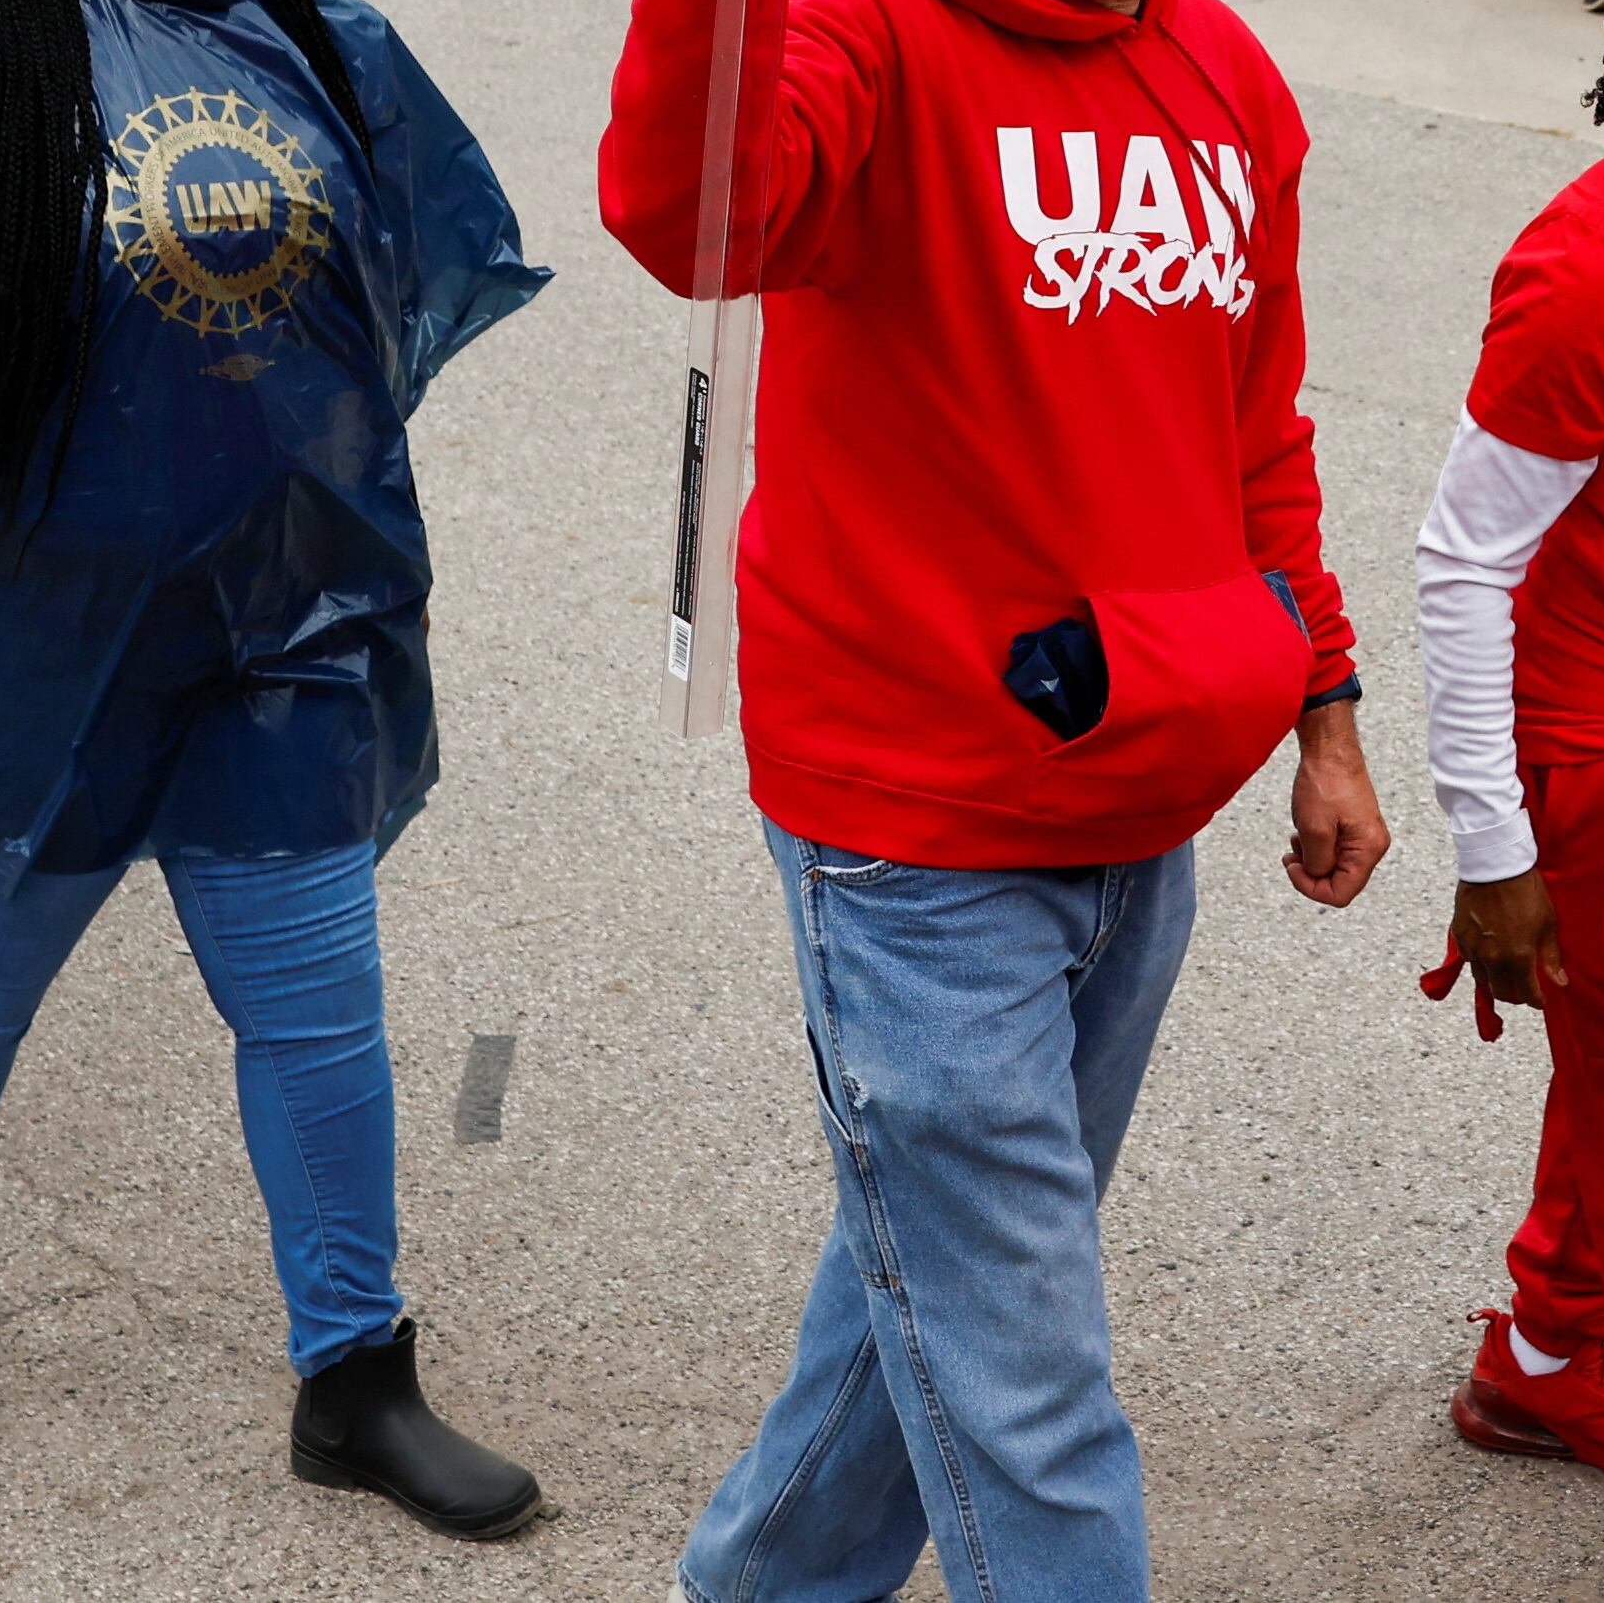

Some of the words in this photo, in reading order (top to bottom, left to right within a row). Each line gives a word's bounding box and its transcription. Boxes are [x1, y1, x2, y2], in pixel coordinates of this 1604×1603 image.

[175, 179, 272, 234] UAW
[996, 126, 1256, 254] UAW
[1023, 229, 1256, 326] STRONG
